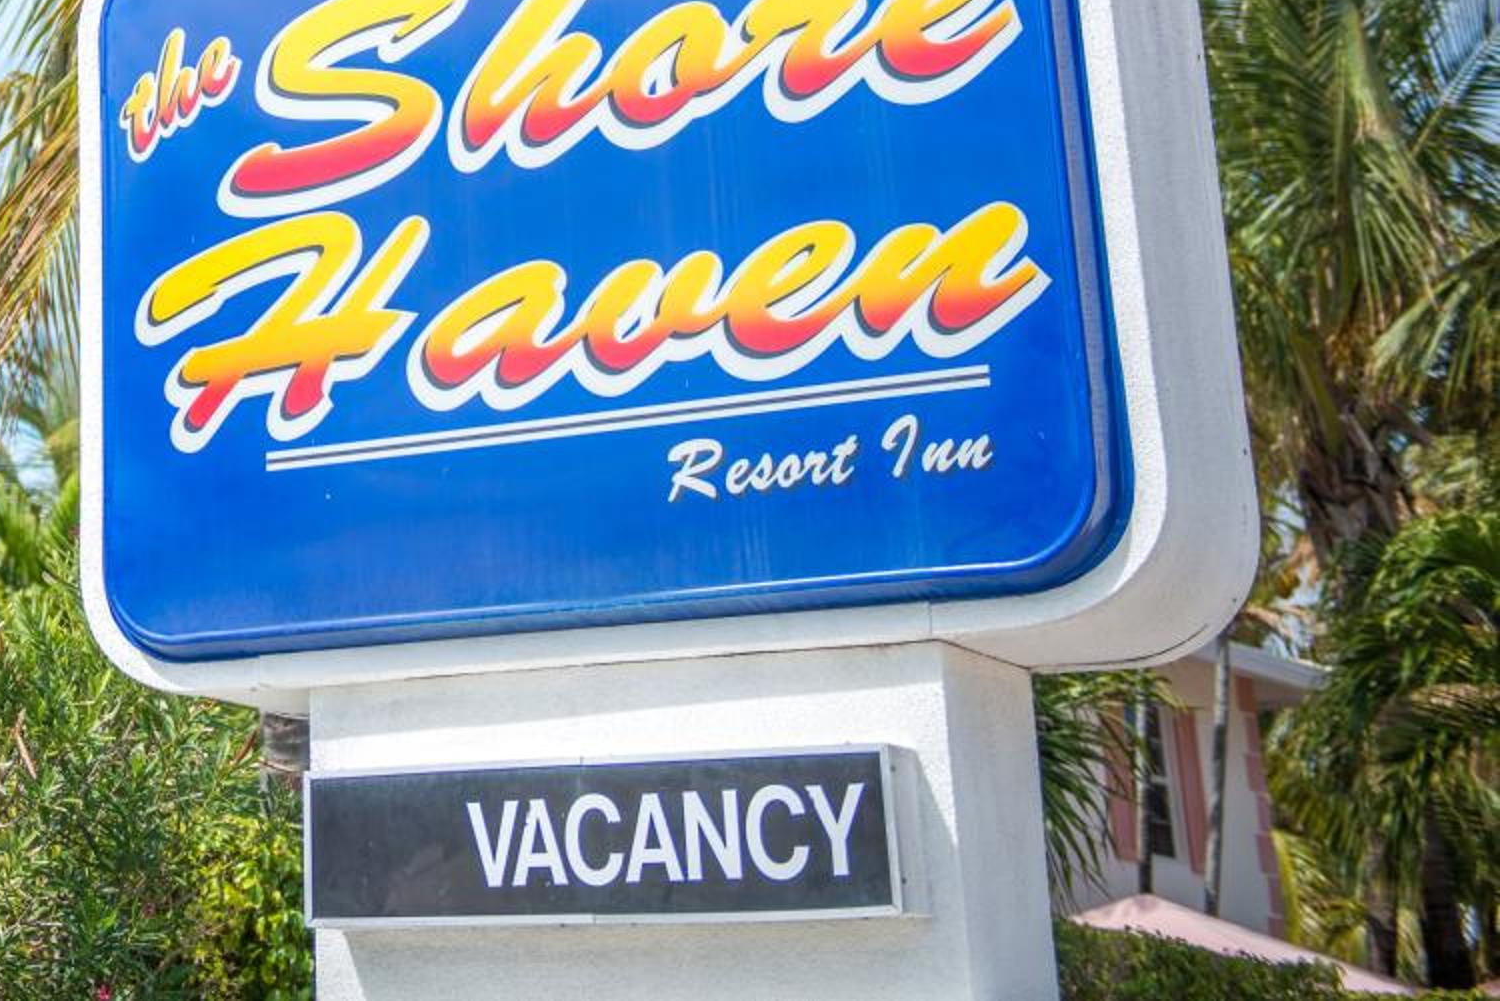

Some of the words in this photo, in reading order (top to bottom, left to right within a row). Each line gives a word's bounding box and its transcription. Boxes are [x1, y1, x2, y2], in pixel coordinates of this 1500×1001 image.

[119, 27, 239, 161] the
[133, 201, 1053, 453] Haven
[667, 433, 860, 504] Resort
[881, 415, 993, 479] Inn
[466, 782, 865, 888] VACANCY
